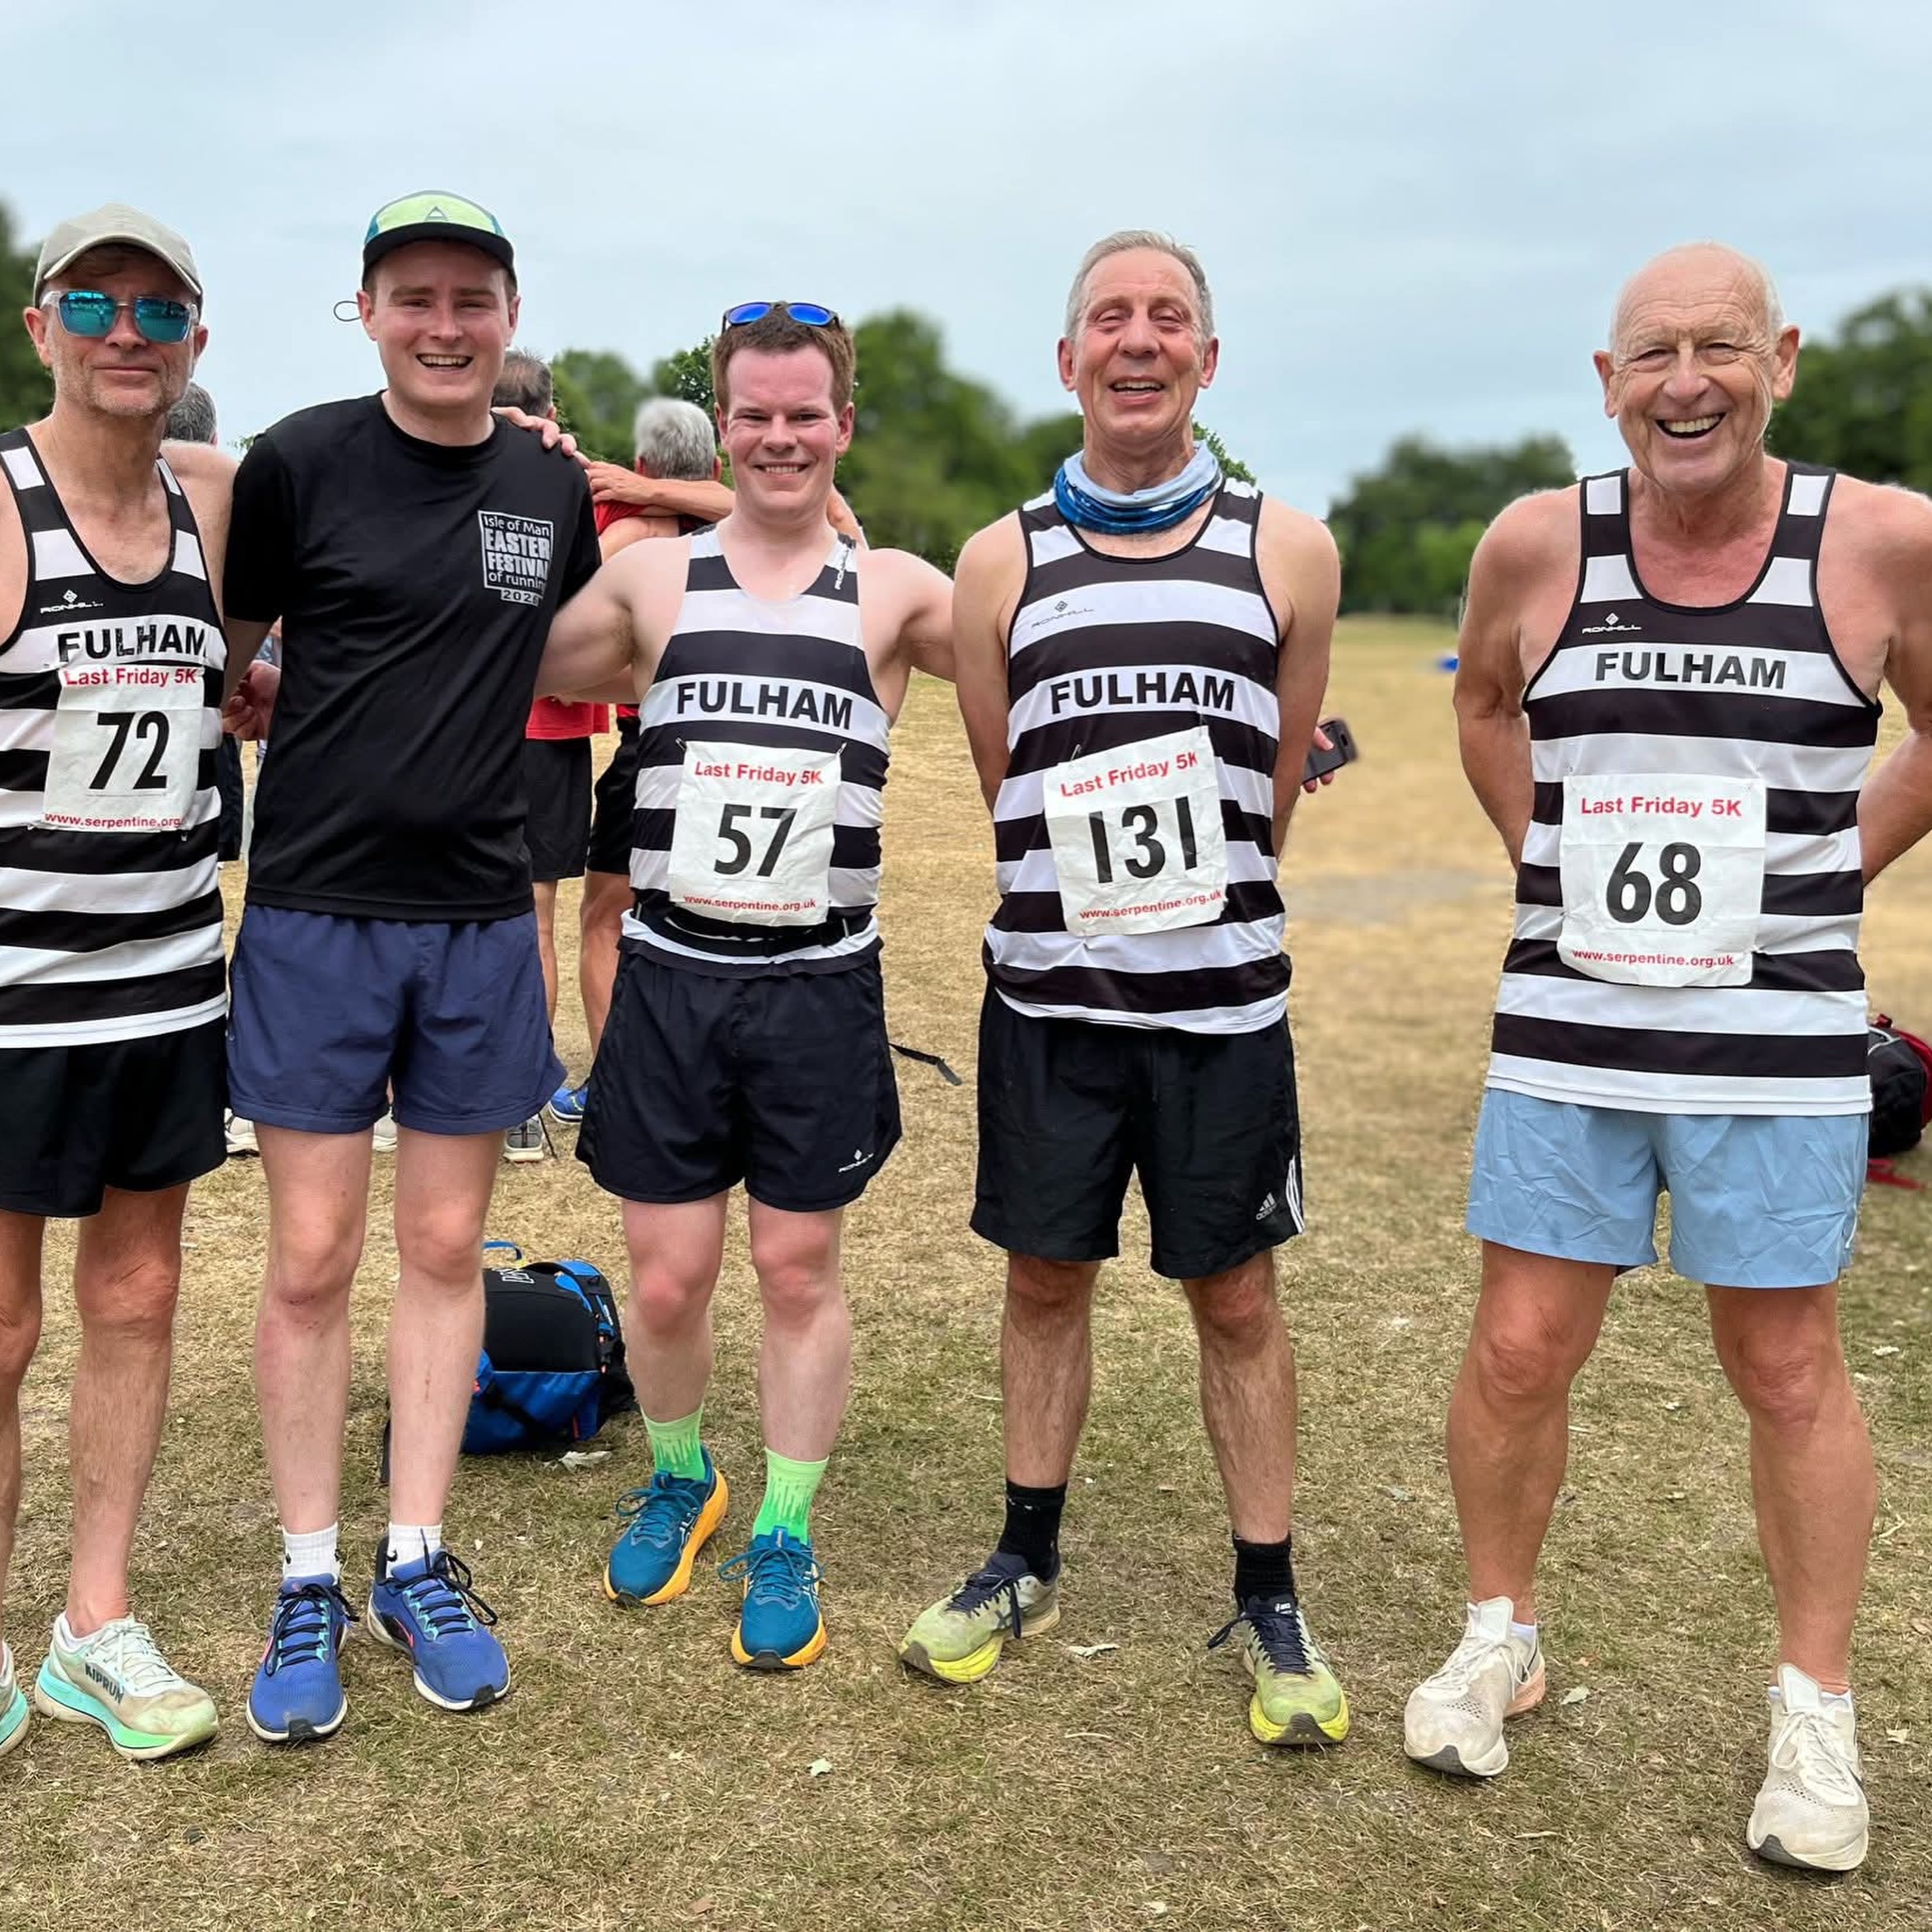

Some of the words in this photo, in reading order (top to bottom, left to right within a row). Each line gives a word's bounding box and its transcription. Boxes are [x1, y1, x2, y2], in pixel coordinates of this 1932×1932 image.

[483, 515, 505, 528] Isle
[507, 520, 522, 532] of
[523, 522, 550, 536] Man
[485, 527, 551, 560] EASTER
[489, 570, 503, 583] of
[57, 624, 208, 663] FULHAM
[63, 668, 109, 685] Last
[115, 668, 170, 688] Friday
[174, 668, 197, 684] 5K
[1594, 652, 1787, 690] FULHAM
[676, 680, 854, 730] FULHAM
[1050, 672, 1235, 715] FULHAM
[89, 710, 171, 790] 72
[694, 761, 732, 778] Last
[737, 764, 797, 787] Friday
[800, 770, 824, 785] 5K
[1060, 775, 1104, 797] Last
[1108, 761, 1170, 787] Friday
[1175, 751, 1199, 770] 5K
[1580, 797, 1624, 815] Last
[1630, 796, 1704, 819] Friday
[1711, 799, 1742, 817] 5K
[713, 803, 798, 877] 57
[1089, 795, 1198, 885] 131
[1605, 841, 1703, 926] 68
[683, 895, 817, 912] www.serpentine.org.uk
[1079, 889, 1224, 920] www.serpentine.org.uk
[1572, 949, 1734, 968] www.serpentine.org.uk
[85, 1661, 125, 1705] KIPRUN
